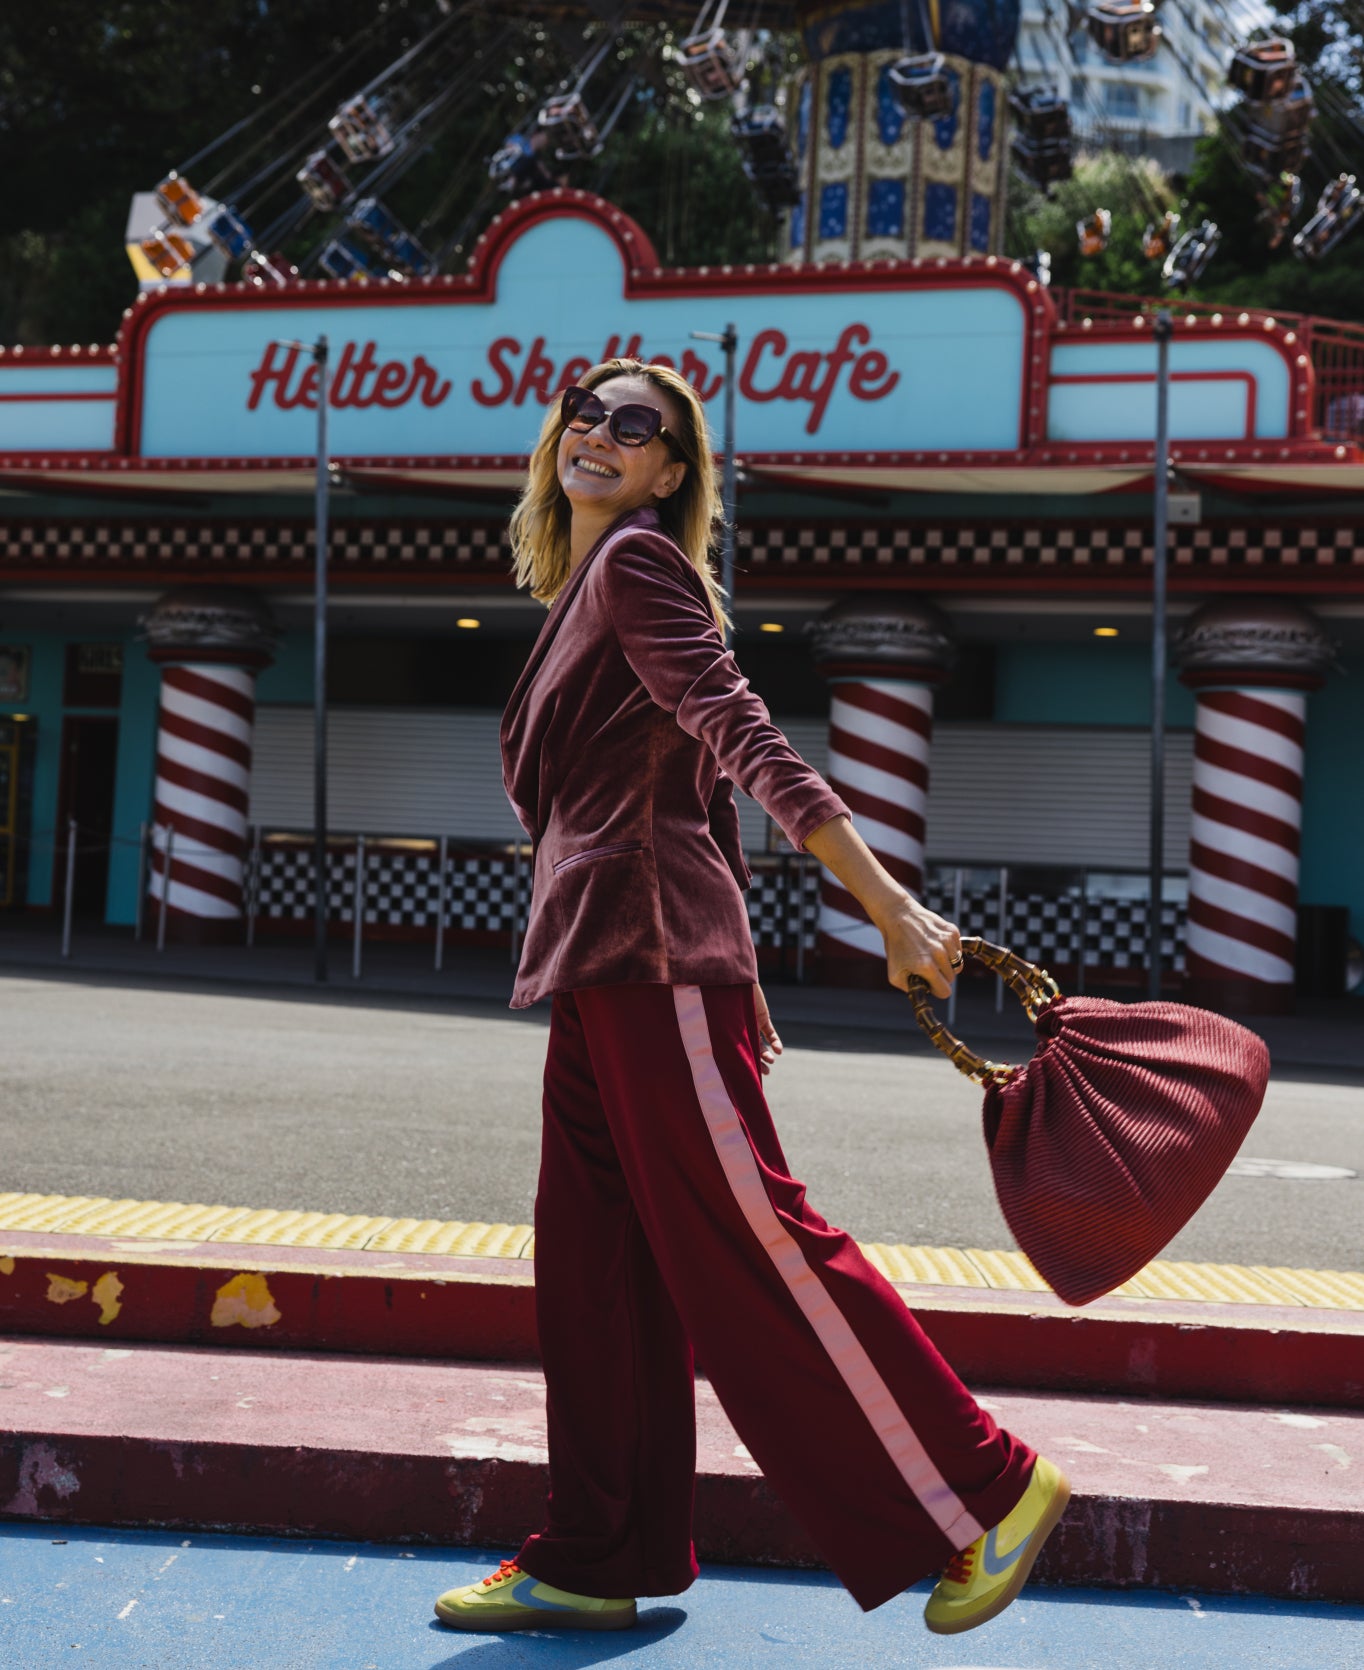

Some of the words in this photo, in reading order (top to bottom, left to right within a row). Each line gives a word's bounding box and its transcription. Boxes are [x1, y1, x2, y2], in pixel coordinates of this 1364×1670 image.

[247, 340, 451, 411] Helter
[471, 334, 724, 406] Sker
[738, 322, 900, 434] Cafe
